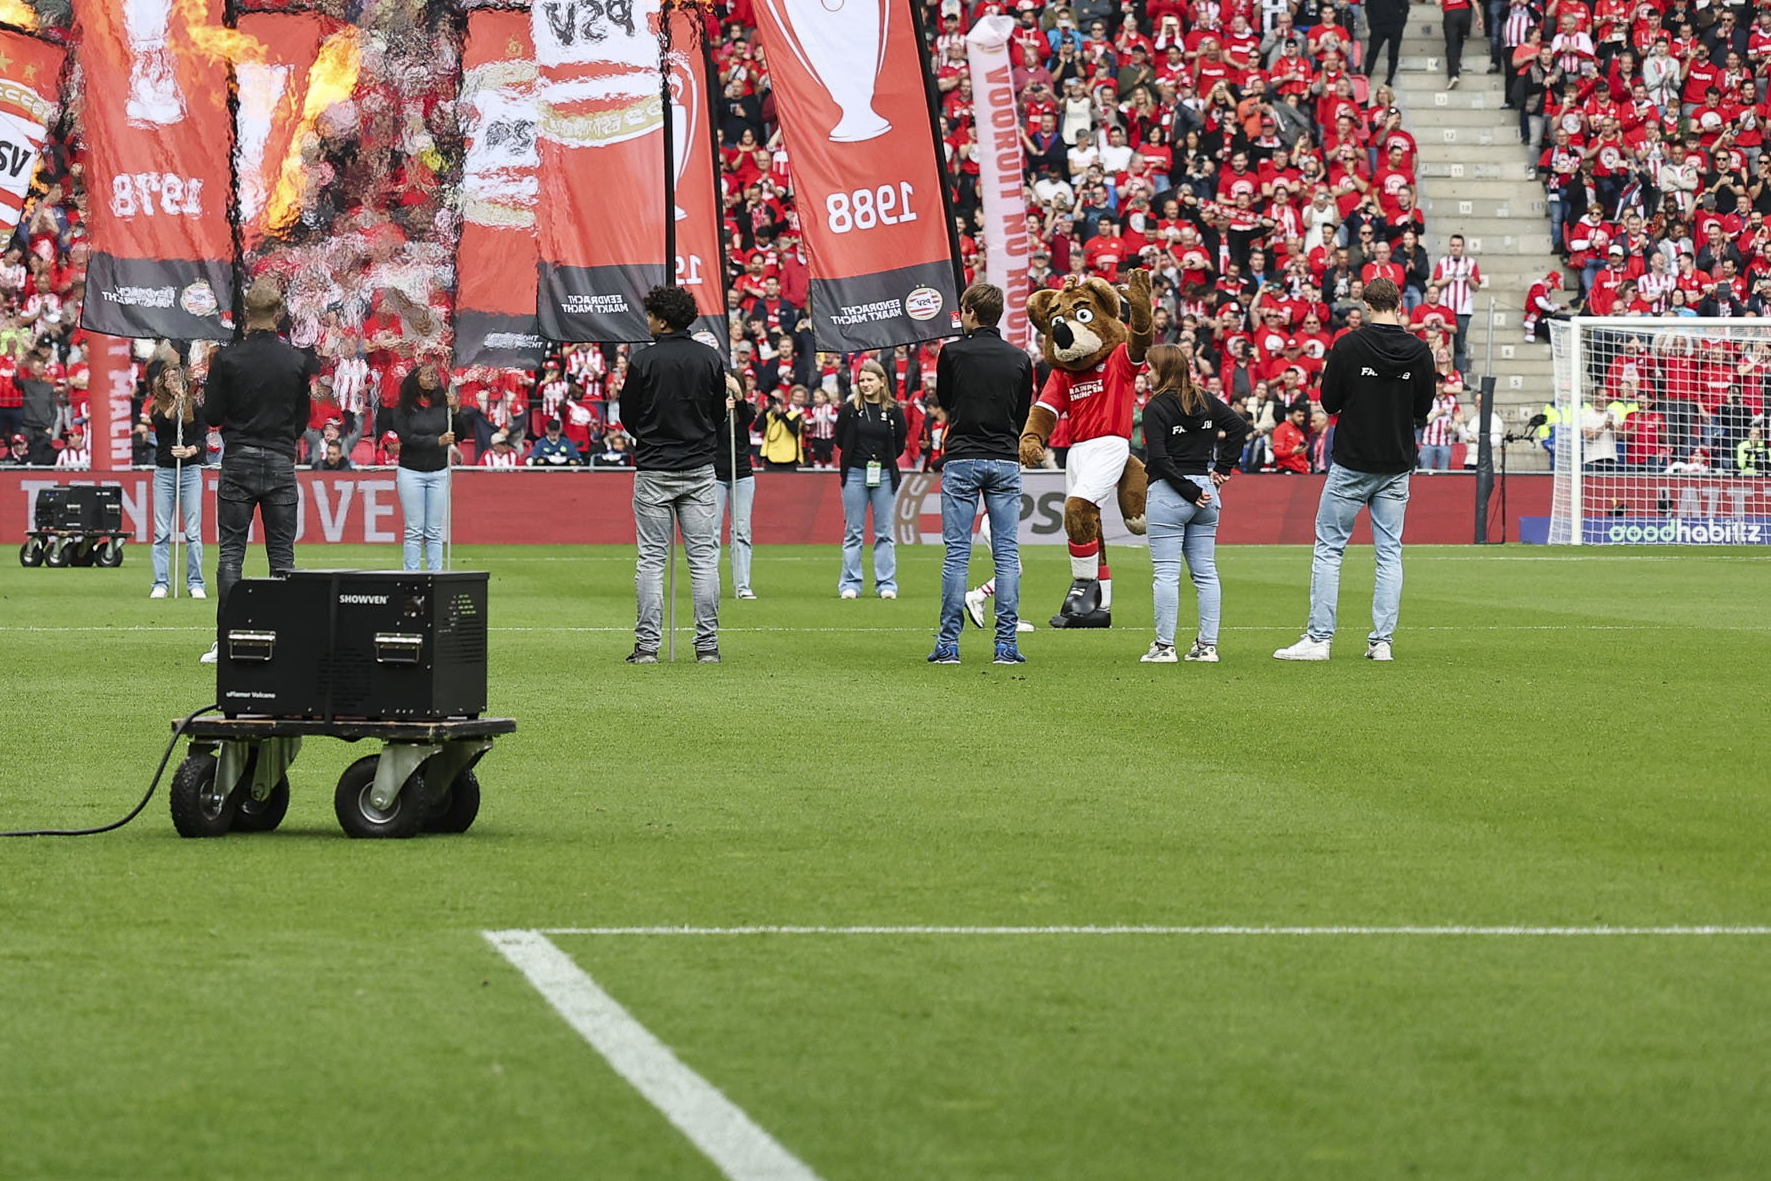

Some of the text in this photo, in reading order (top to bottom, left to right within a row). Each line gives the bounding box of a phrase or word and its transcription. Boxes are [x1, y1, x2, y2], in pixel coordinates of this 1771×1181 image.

[984, 65, 1023, 201] VOORUIT
[1002, 212, 1028, 257] NU
[339, 594, 388, 605] SHOWVEN
